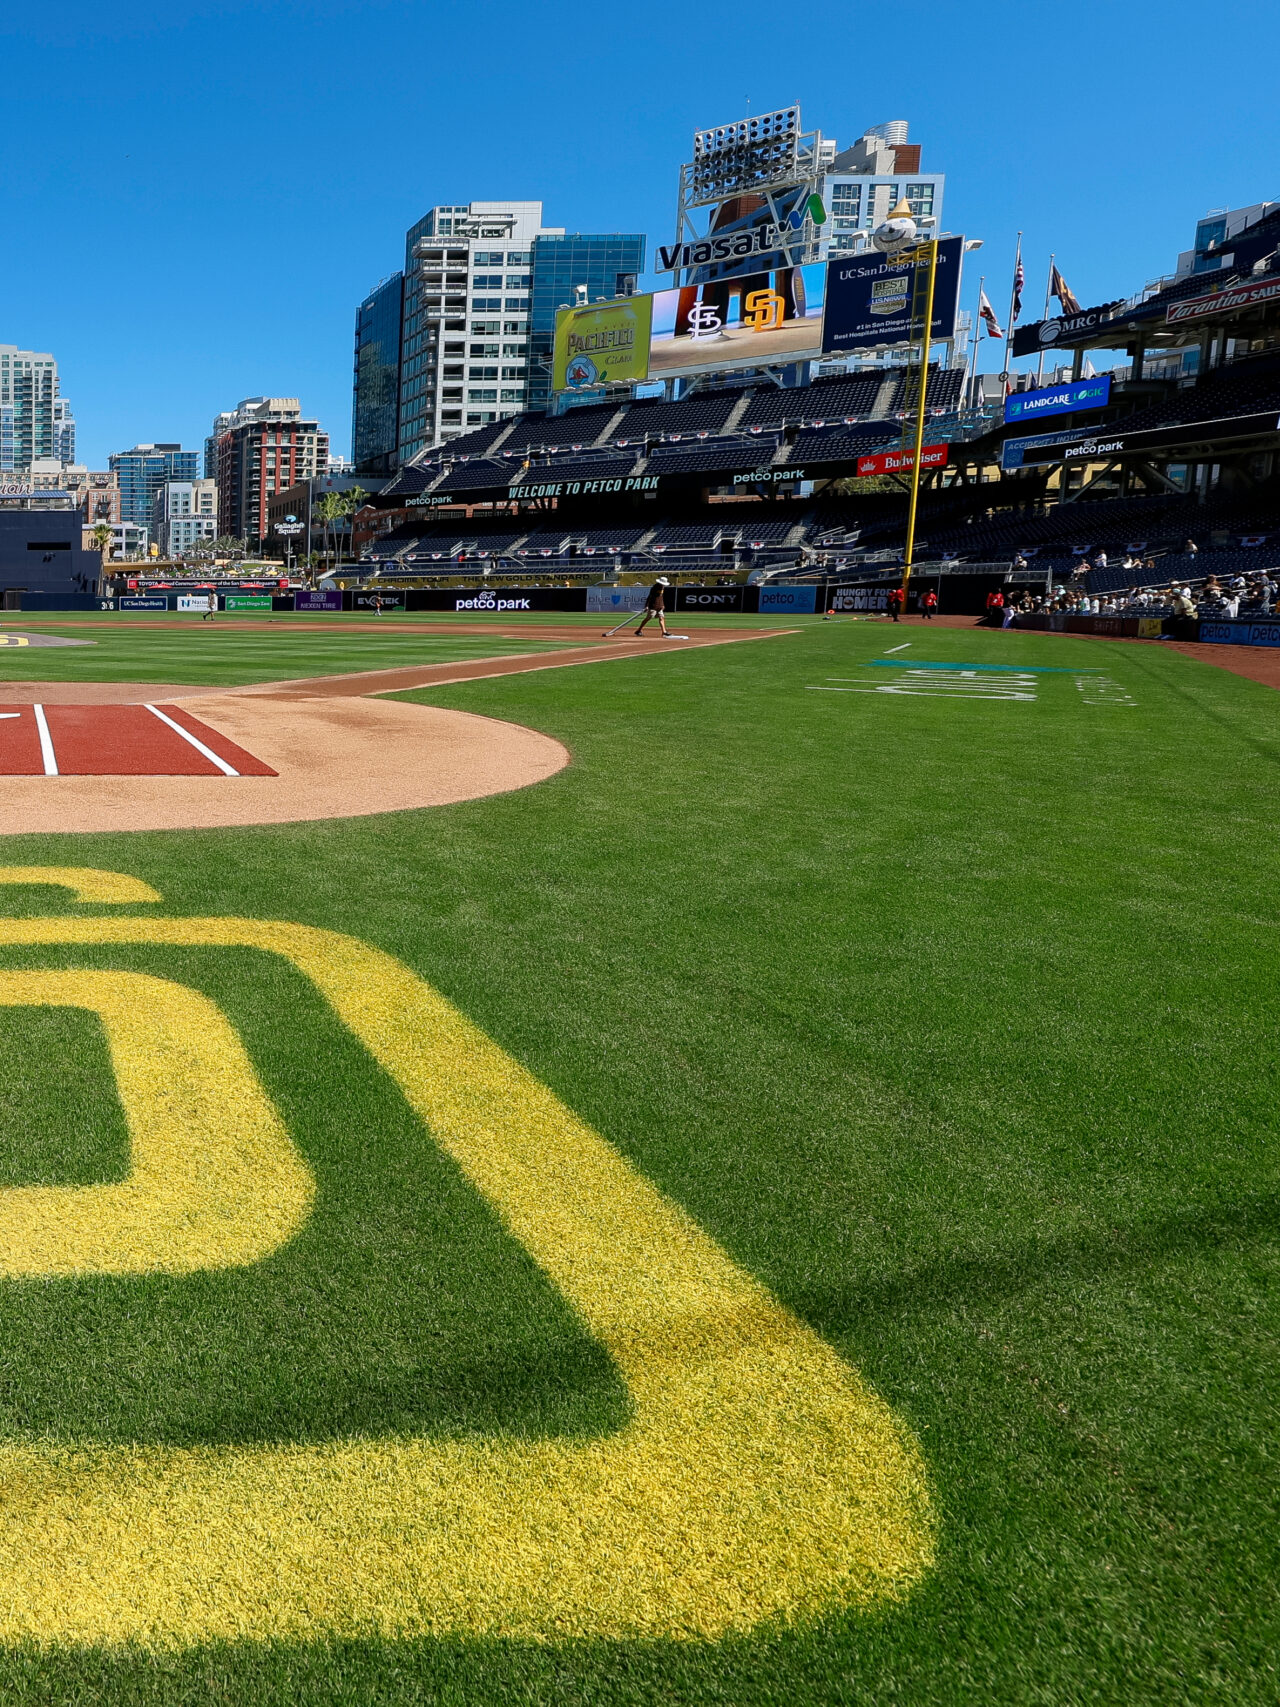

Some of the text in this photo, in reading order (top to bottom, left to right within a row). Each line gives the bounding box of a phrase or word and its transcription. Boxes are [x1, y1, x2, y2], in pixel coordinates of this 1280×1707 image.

[658, 225, 773, 270] Viasat
[840, 269, 856, 281] UC
[857, 267, 878, 278] San
[875, 279, 907, 291] BEST
[1168, 291, 1250, 320] Tarantino
[1061, 314, 1097, 332] MRC
[567, 328, 634, 356] PACIFICO
[1023, 393, 1070, 410] LANDCARE
[1065, 441, 1125, 459] petco park
[885, 452, 943, 469] Budwiser
[733, 468, 805, 485] petco park
[508, 476, 660, 499] WELCOME TO PETCO PARK
[405, 495, 453, 507] petco park
[456, 598, 531, 611] petco park
[685, 594, 737, 604] SONY
[761, 591, 795, 604] petco
[832, 596, 888, 609] HOMER
[1201, 623, 1231, 640] petco
